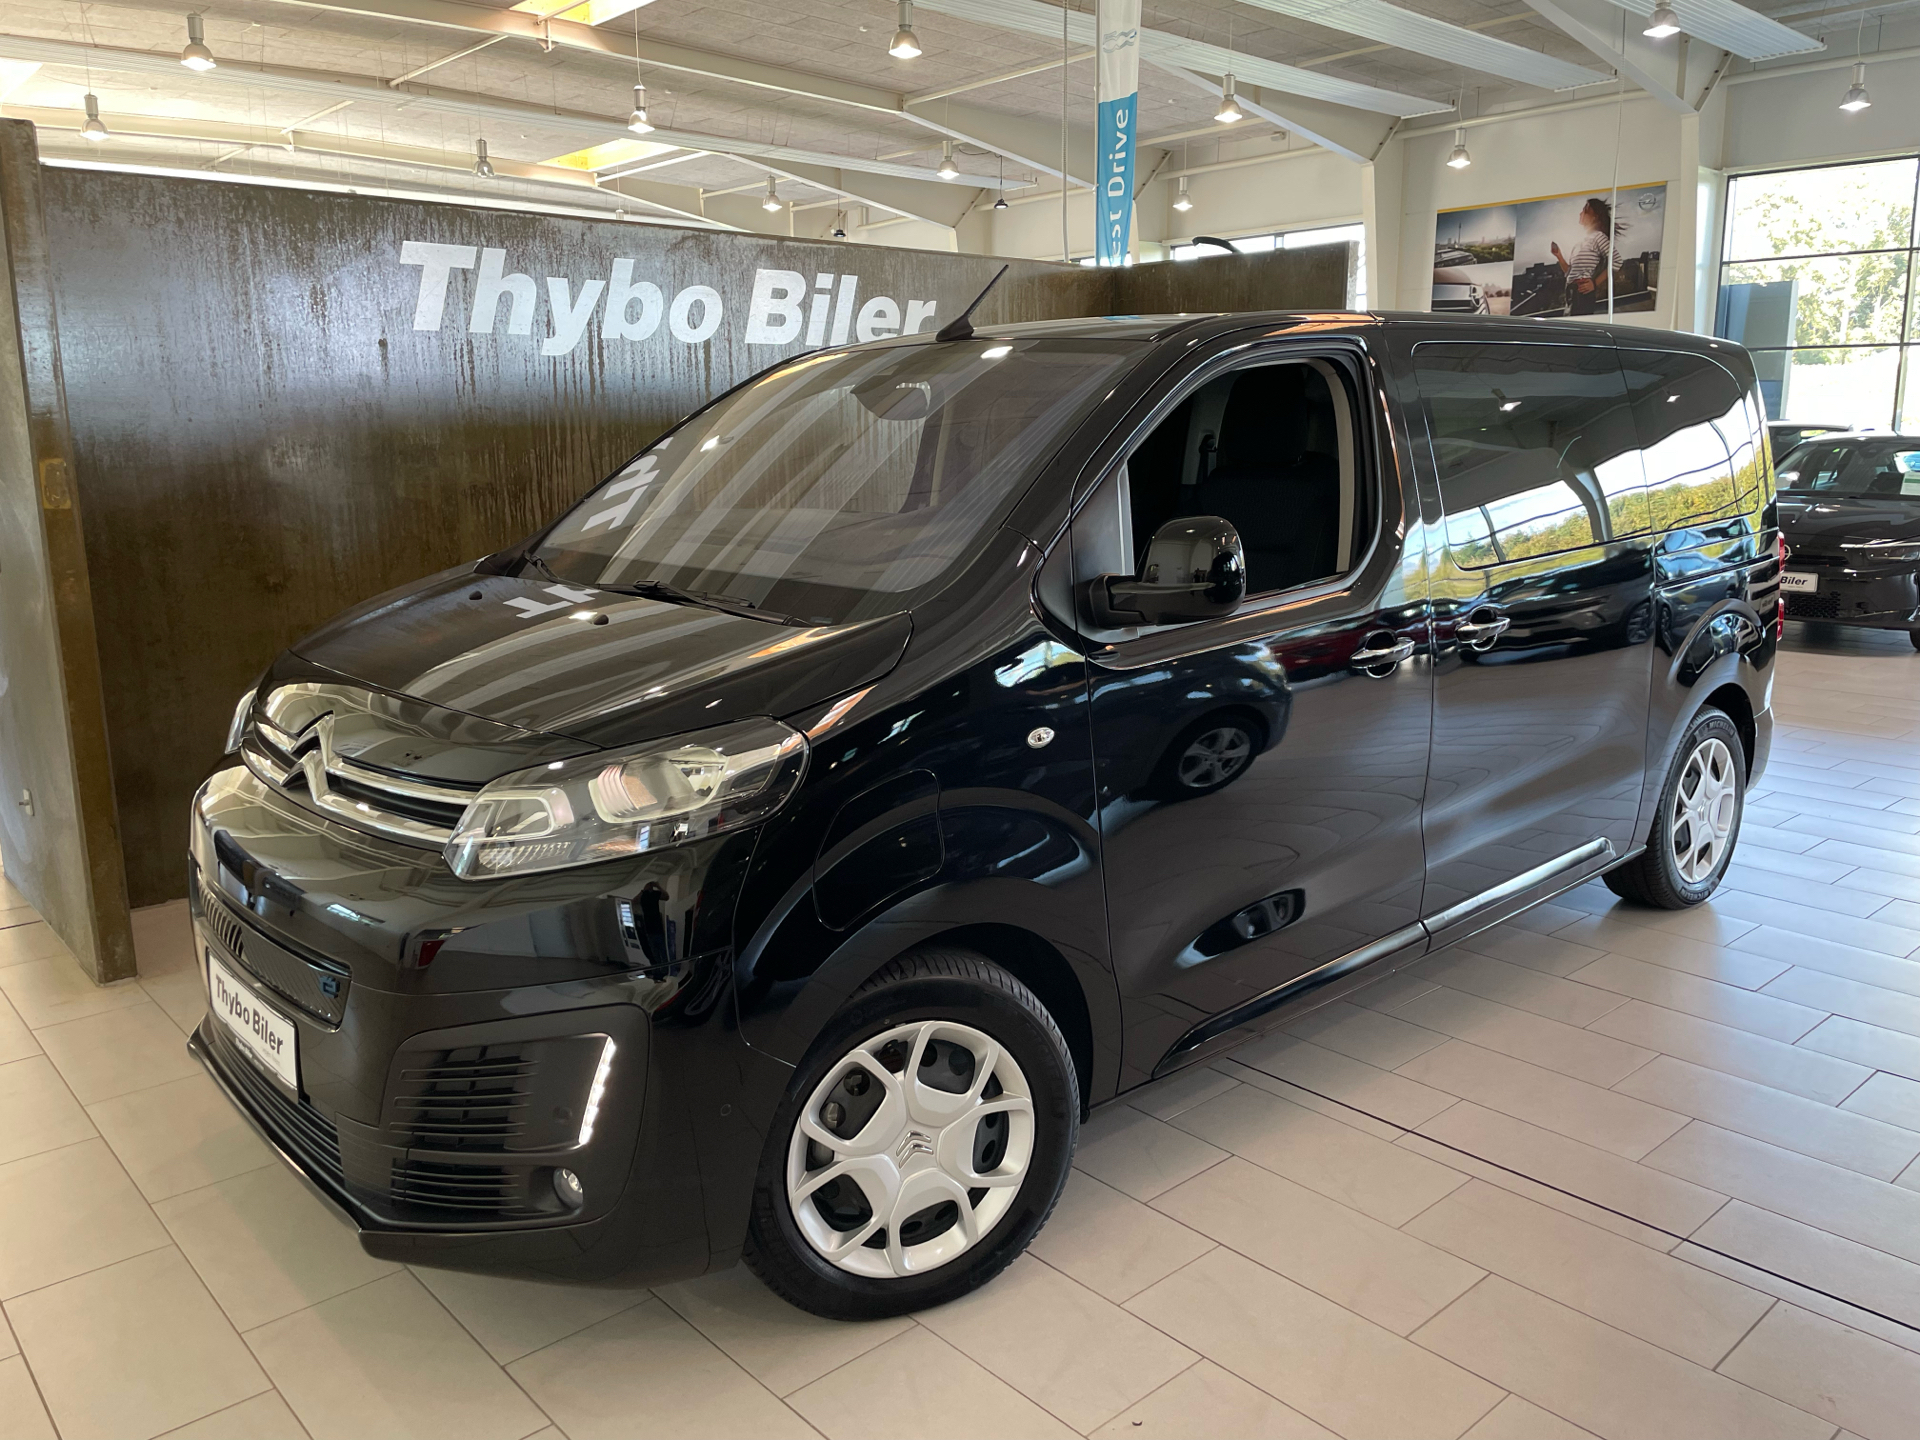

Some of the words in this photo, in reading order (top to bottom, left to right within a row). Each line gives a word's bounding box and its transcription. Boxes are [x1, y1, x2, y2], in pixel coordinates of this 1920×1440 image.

[1107, 108, 1129, 197] Drive
[400, 240, 723, 356] Thybo
[744, 268, 937, 347] Biler
[1780, 575, 1808, 586] Biler
[215, 973, 250, 1026] Thybo
[252, 1007, 284, 1055] Biler
